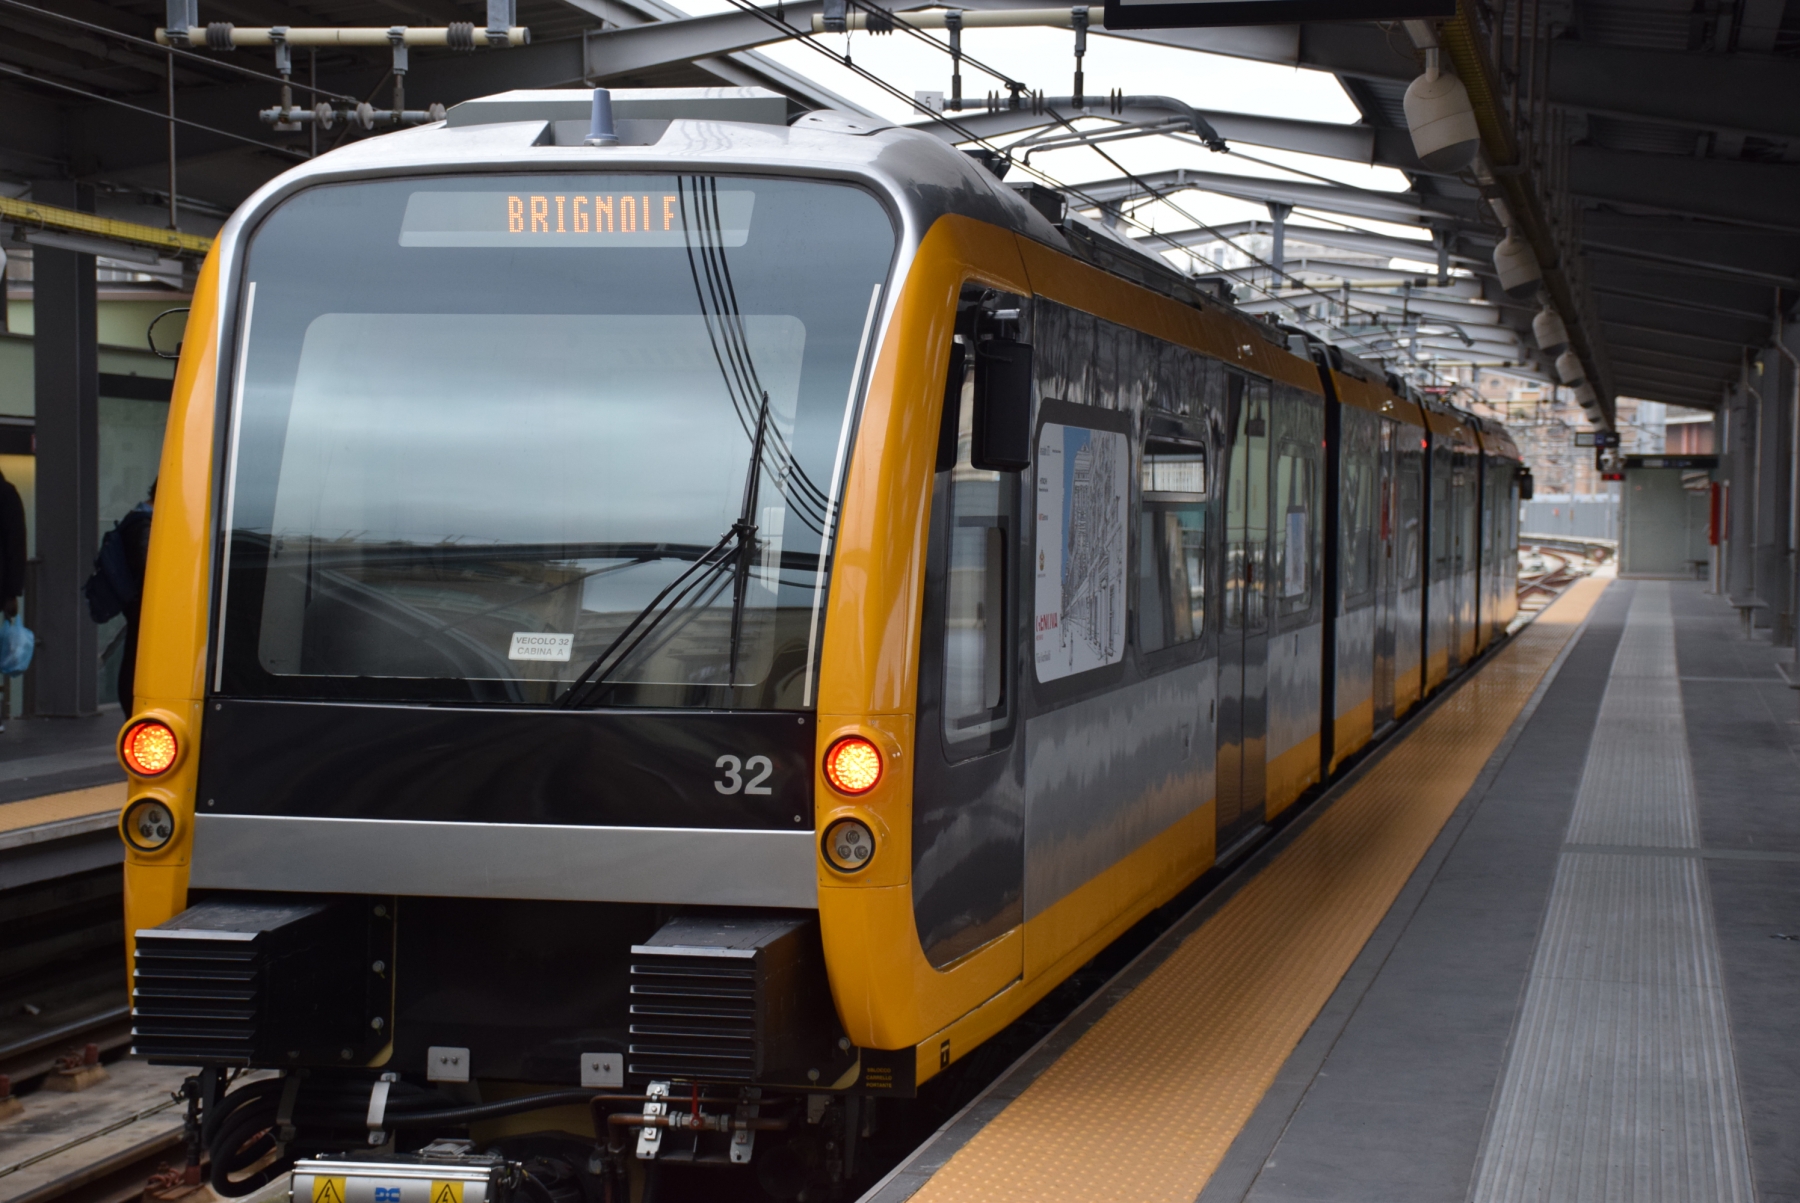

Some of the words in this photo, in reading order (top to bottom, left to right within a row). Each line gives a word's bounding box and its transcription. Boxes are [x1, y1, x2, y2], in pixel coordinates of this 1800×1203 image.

[516, 637, 556, 645] VEICOLO
[558, 638, 569, 646] 32
[517, 647, 552, 656] CABINA
[557, 648, 563, 656] A
[714, 754, 773, 795] 32
